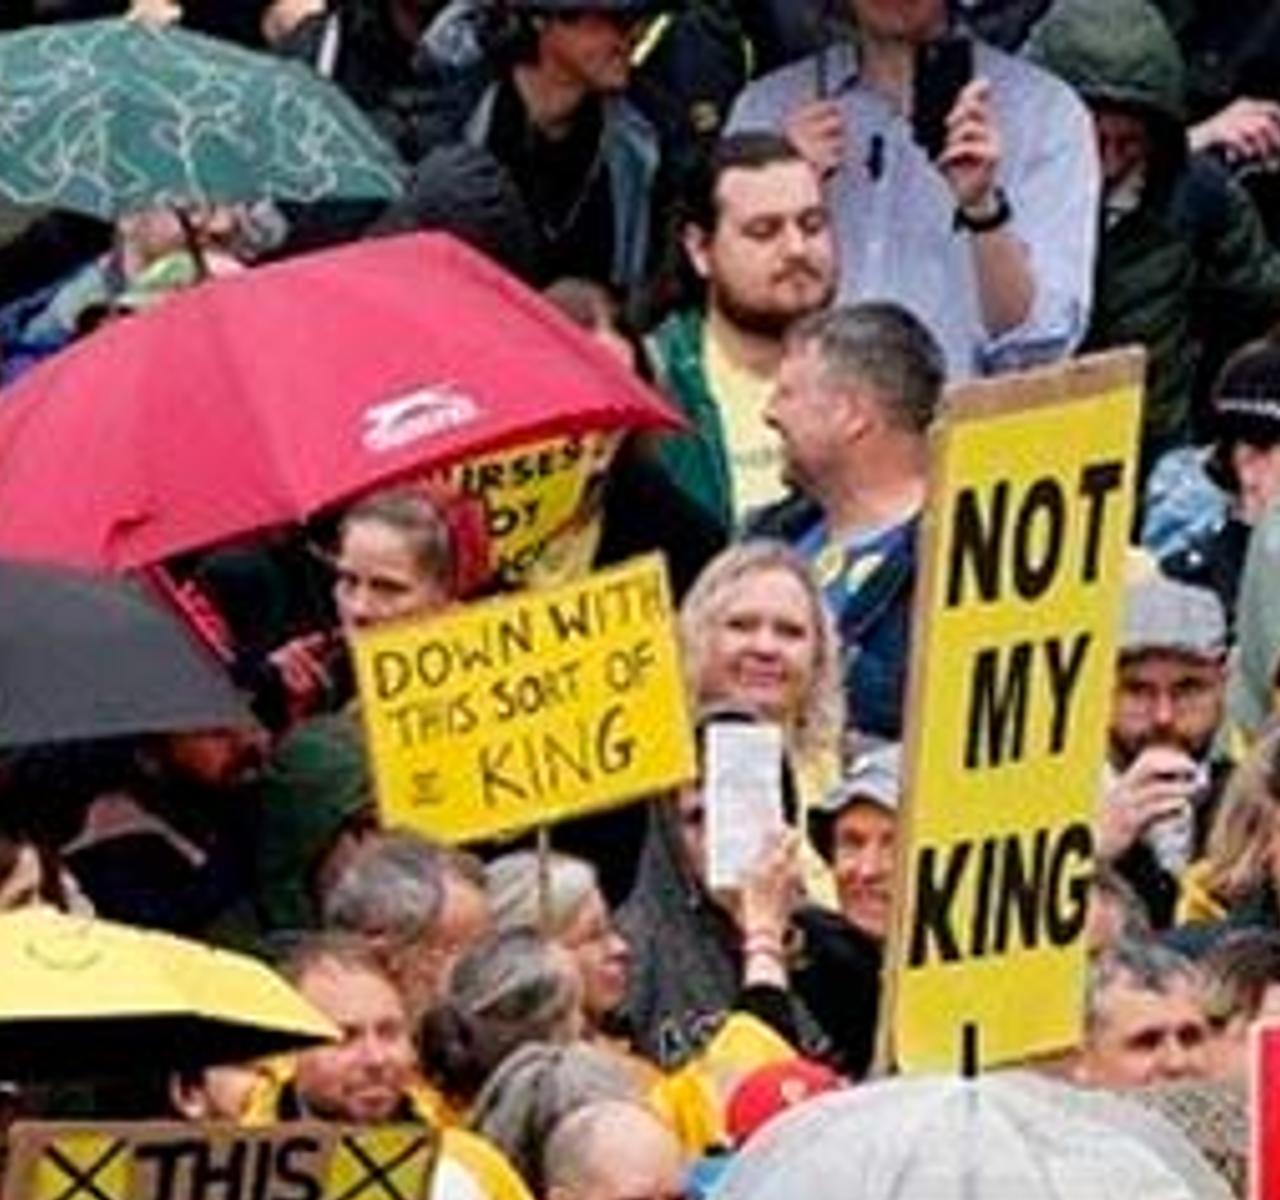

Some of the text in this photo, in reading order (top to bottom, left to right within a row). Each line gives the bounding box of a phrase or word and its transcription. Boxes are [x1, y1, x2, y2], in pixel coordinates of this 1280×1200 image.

[946, 460, 1125, 608] NOT
[373, 572, 666, 700] DOWN WITH
[388, 639, 657, 748] THIS SORT OF
[964, 631, 1093, 770] MY
[477, 705, 637, 808] KING
[907, 822, 1095, 968] KING
